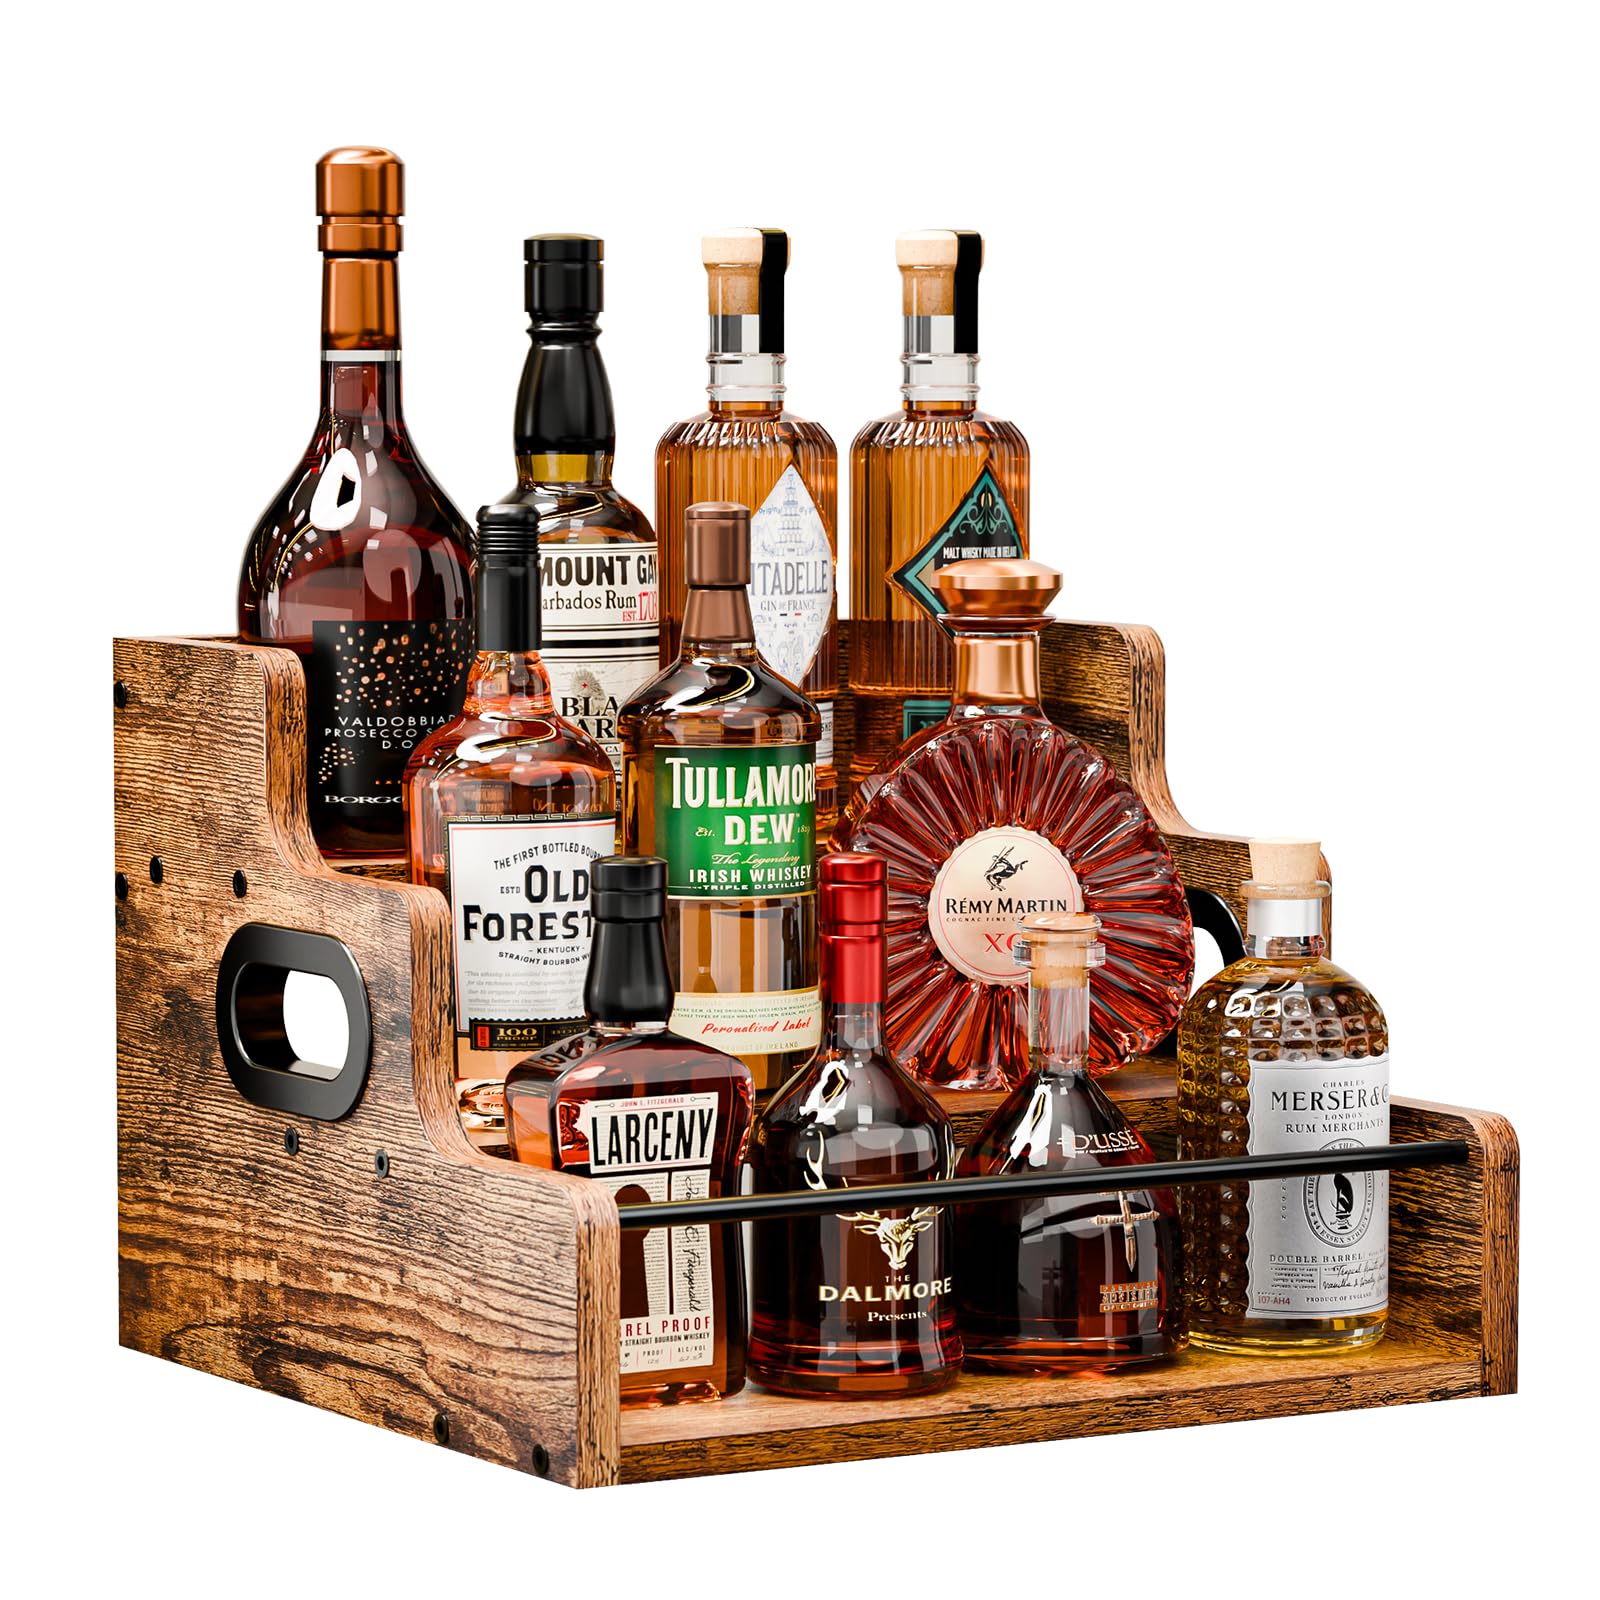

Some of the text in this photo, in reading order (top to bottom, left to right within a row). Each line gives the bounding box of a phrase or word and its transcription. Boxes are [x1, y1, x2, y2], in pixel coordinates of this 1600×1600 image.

[943, 547, 960, 559] MALT
[961, 547, 982, 558] WHISKY
[983, 546, 996, 558] MADE
[540, 555, 630, 586] MOUNT
[751, 560, 828, 595] ITADELLE
[543, 590, 637, 609] arbados Rum
[622, 591, 657, 622] EST. 1703
[760, 600, 777, 611] GIN
[787, 599, 816, 611] FRANCE
[561, 696, 619, 717] BLA
[325, 728, 417, 738] PROSECCO
[695, 826, 715, 837] Est.
[493, 859, 511, 871] THE
[513, 845, 539, 865] FIRST
[542, 841, 579, 857] BOTTLED
[711, 852, 801, 869] The Legendary
[689, 864, 812, 883] IRISH WHISKEY
[500, 864, 590, 903] ESTD OLD
[752, 880, 805, 890] DISTILLED
[946, 898, 1067, 914] RÉMY MARTIN
[536, 945, 580, 954] KENTUCKY
[498, 951, 541, 965] STRAIGHT
[543, 956, 582, 966] BOURBON
[496, 1027, 537, 1037] 100
[701, 1016, 811, 1035] Peronalised Label
[1322, 1080, 1365, 1088] CHARLES
[647, 1097, 684, 1106] FITZGERALD
[1325, 1112, 1363, 1121] LONDON
[1285, 1118, 1384, 1133] RUM MERCHANTS
[591, 1107, 713, 1166] LARCENY
[1319, 1229, 1344, 1244] ESSEX
[1270, 1253, 1363, 1263] DOUBLE BARREL
[884, 1274, 911, 1282] THE
[819, 1276, 952, 1302] DALMORE
[1349, 1292, 1372, 1300] ENGLAND
[867, 1311, 927, 1322] Presents
[619, 1316, 710, 1337] REL PROOF
[625, 1337, 652, 1346] STRAIGHT
[655, 1335, 681, 1344] BOURBON
[683, 1332, 710, 1340] WHISKEY
